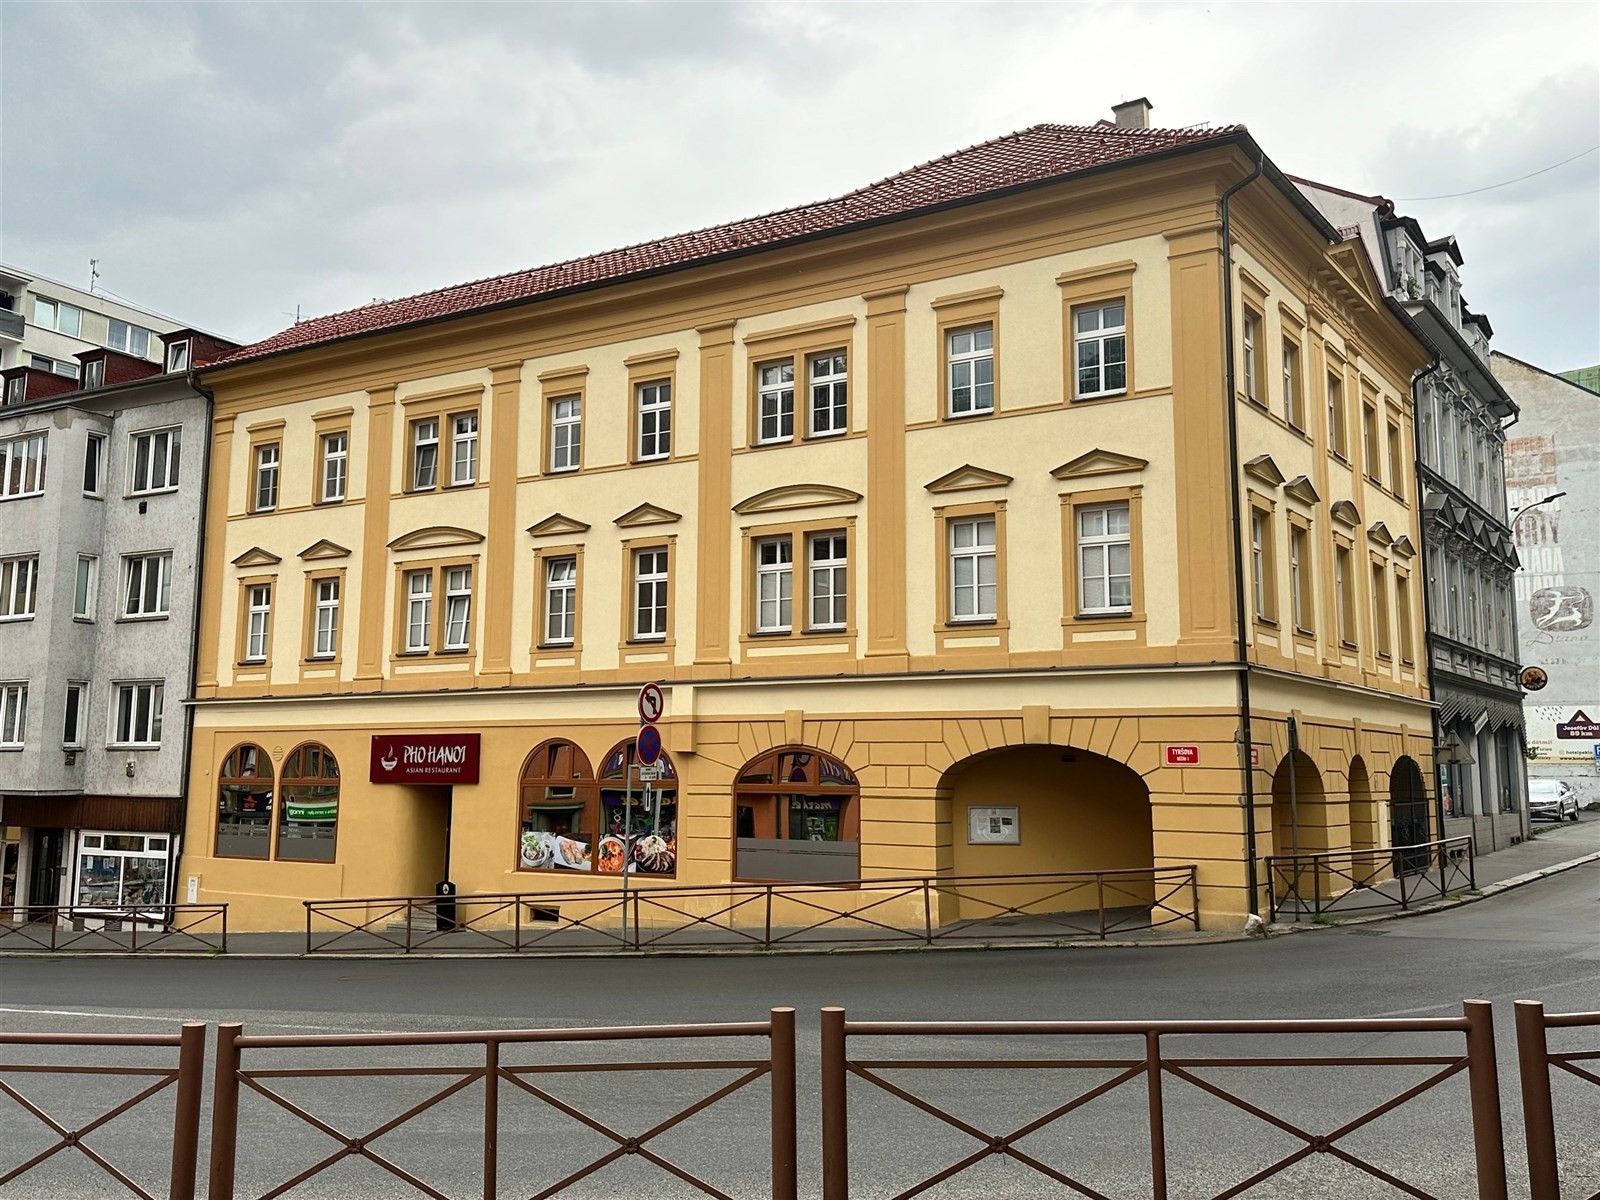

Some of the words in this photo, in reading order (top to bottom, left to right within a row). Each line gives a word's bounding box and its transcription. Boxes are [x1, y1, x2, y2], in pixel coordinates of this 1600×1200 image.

[403, 745, 426, 764] PHO
[427, 745, 466, 765] HANOI
[1172, 747, 1194, 755] TYRŠOVA
